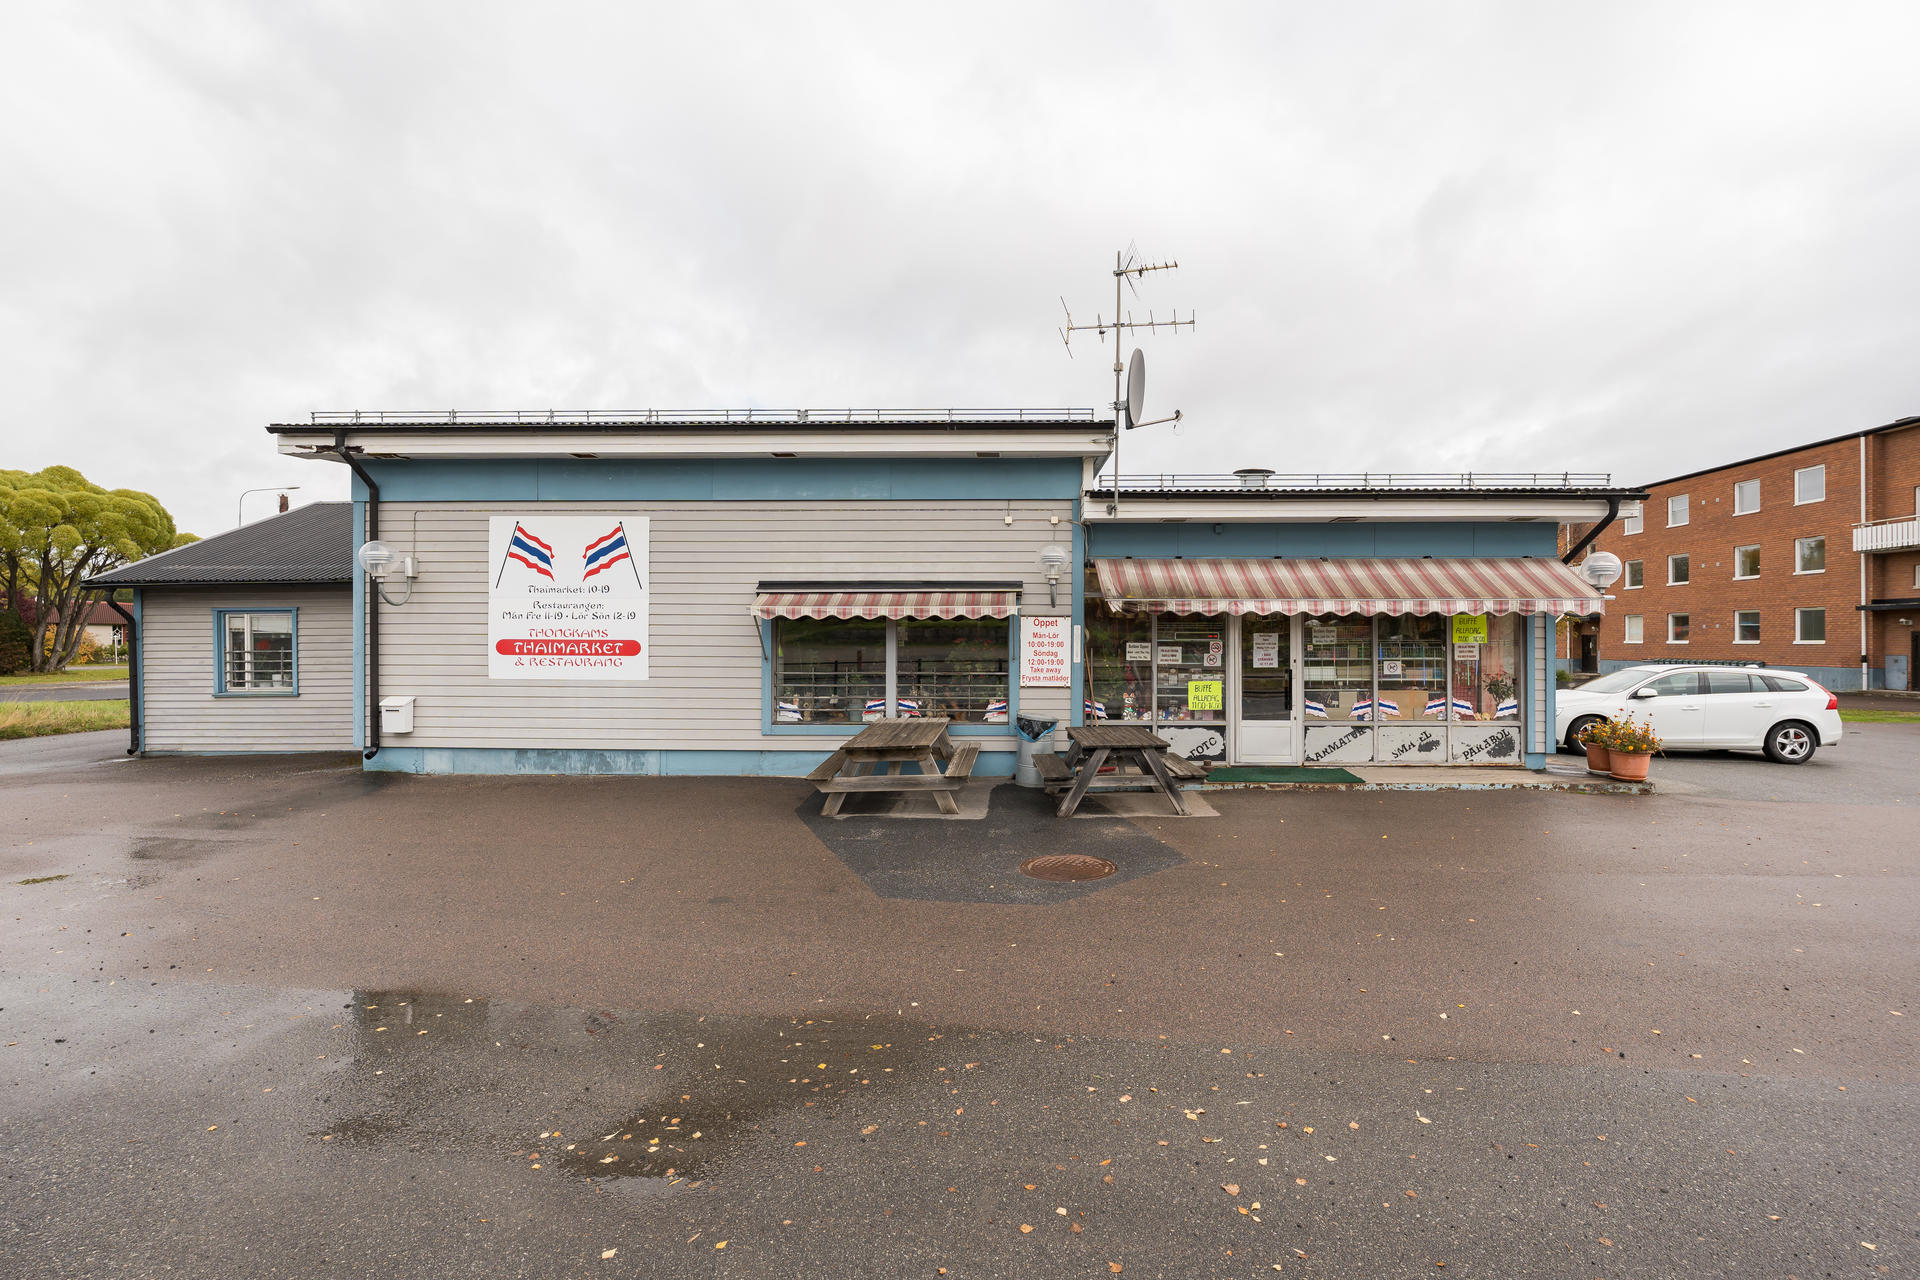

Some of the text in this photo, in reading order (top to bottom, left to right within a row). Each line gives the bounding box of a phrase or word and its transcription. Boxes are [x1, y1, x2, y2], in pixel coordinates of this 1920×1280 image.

[528, 584, 611, 594] Thaimarket: 10-19
[532, 600, 605, 612] Restaurangen:
[526, 611, 542, 620] Fre
[544, 611, 564, 620] 11-19
[613, 610, 637, 620] 12-19
[1033, 617, 1059, 629] Öppet
[513, 641, 624, 654] THAIMARKET
[1028, 640, 1065, 648] 10:00-19:00
[514, 656, 623, 667] & RESTAURANG
[1028, 658, 1065, 666] 12:00-19:00
[1045, 667, 1062, 675] away
[1021, 674, 1041, 683] Frysta
